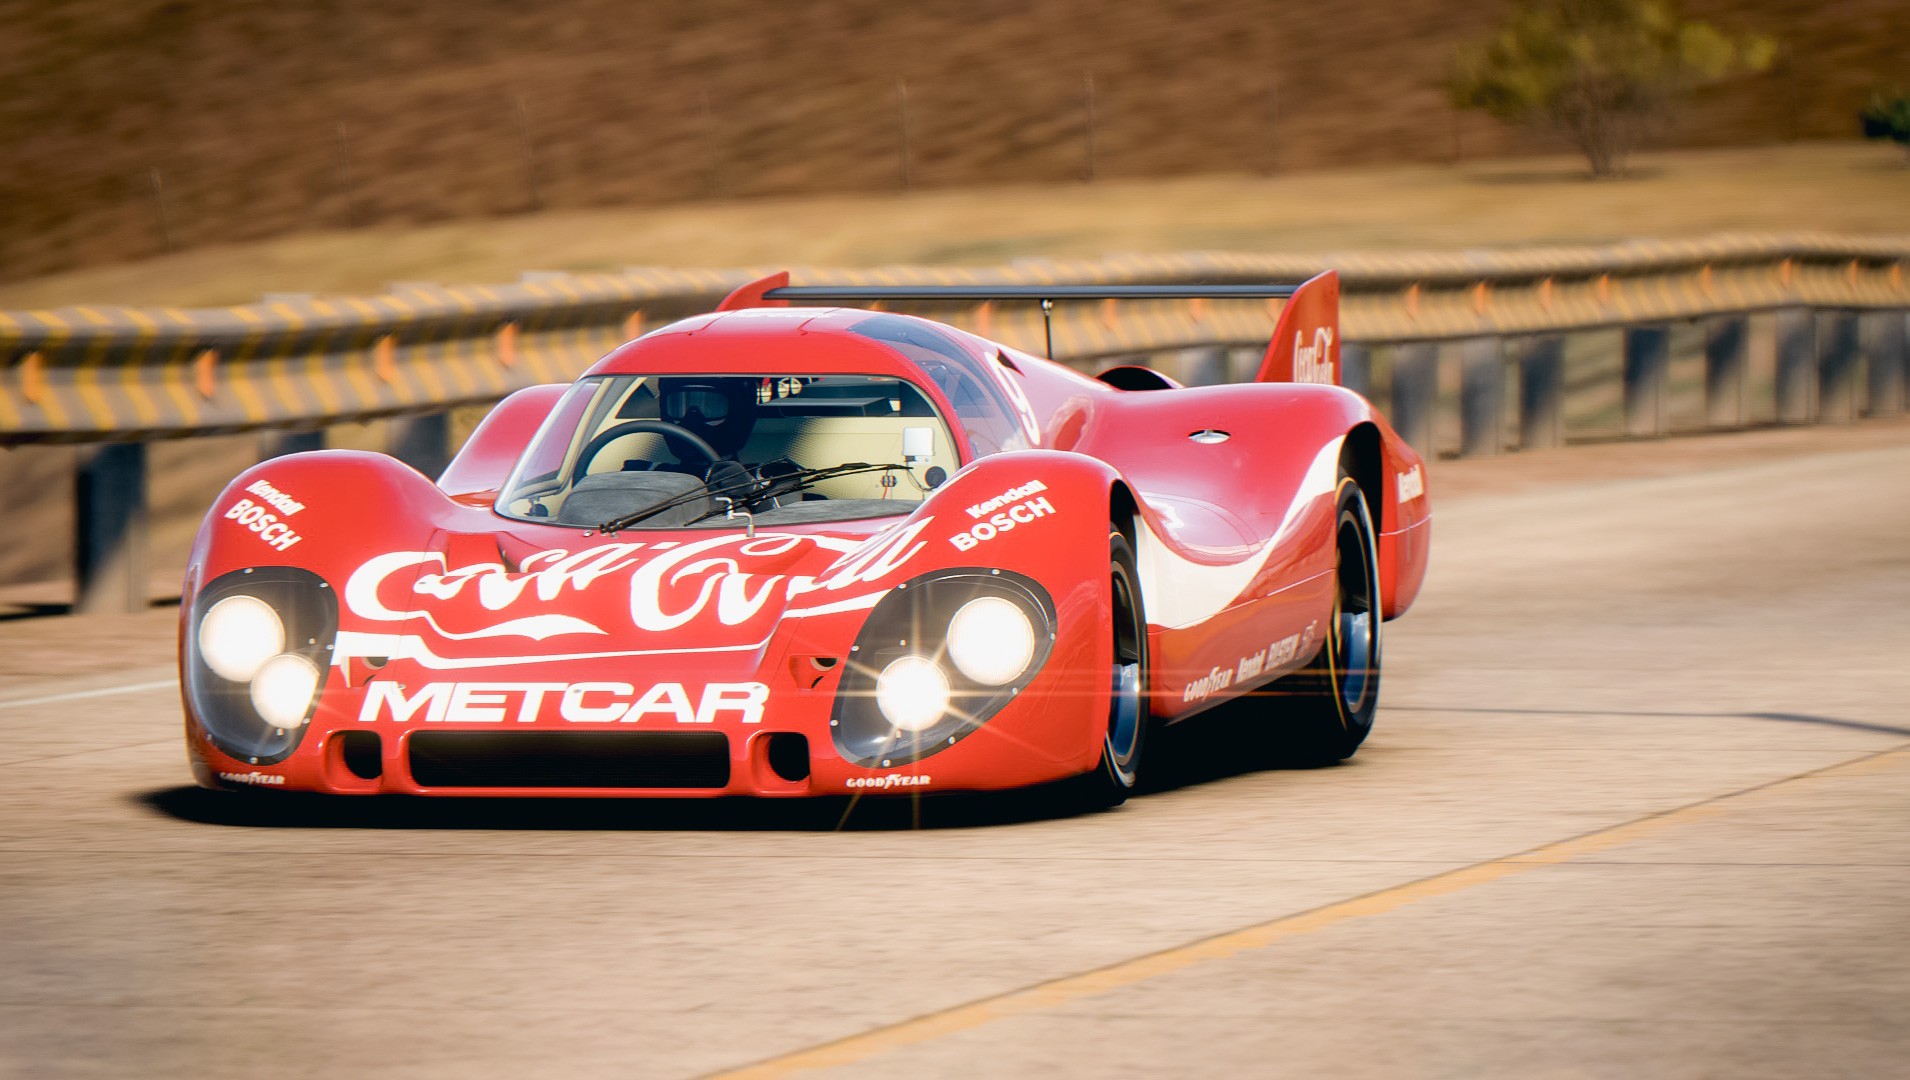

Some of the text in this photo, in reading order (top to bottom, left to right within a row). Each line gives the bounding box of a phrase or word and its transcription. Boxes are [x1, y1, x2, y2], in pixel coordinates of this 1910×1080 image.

[244, 479, 306, 516] Kendall
[964, 479, 1048, 519] Kendall
[224, 498, 303, 552] BOSCH
[948, 496, 1056, 552] BOSCH
[344, 516, 935, 641] Coca-Cola
[358, 680, 770, 724] METCAR
[1183, 666, 1233, 702] GOODYEAR
[220, 771, 285, 785] GOODYEAR
[846, 773, 931, 790] GOODYEAR
